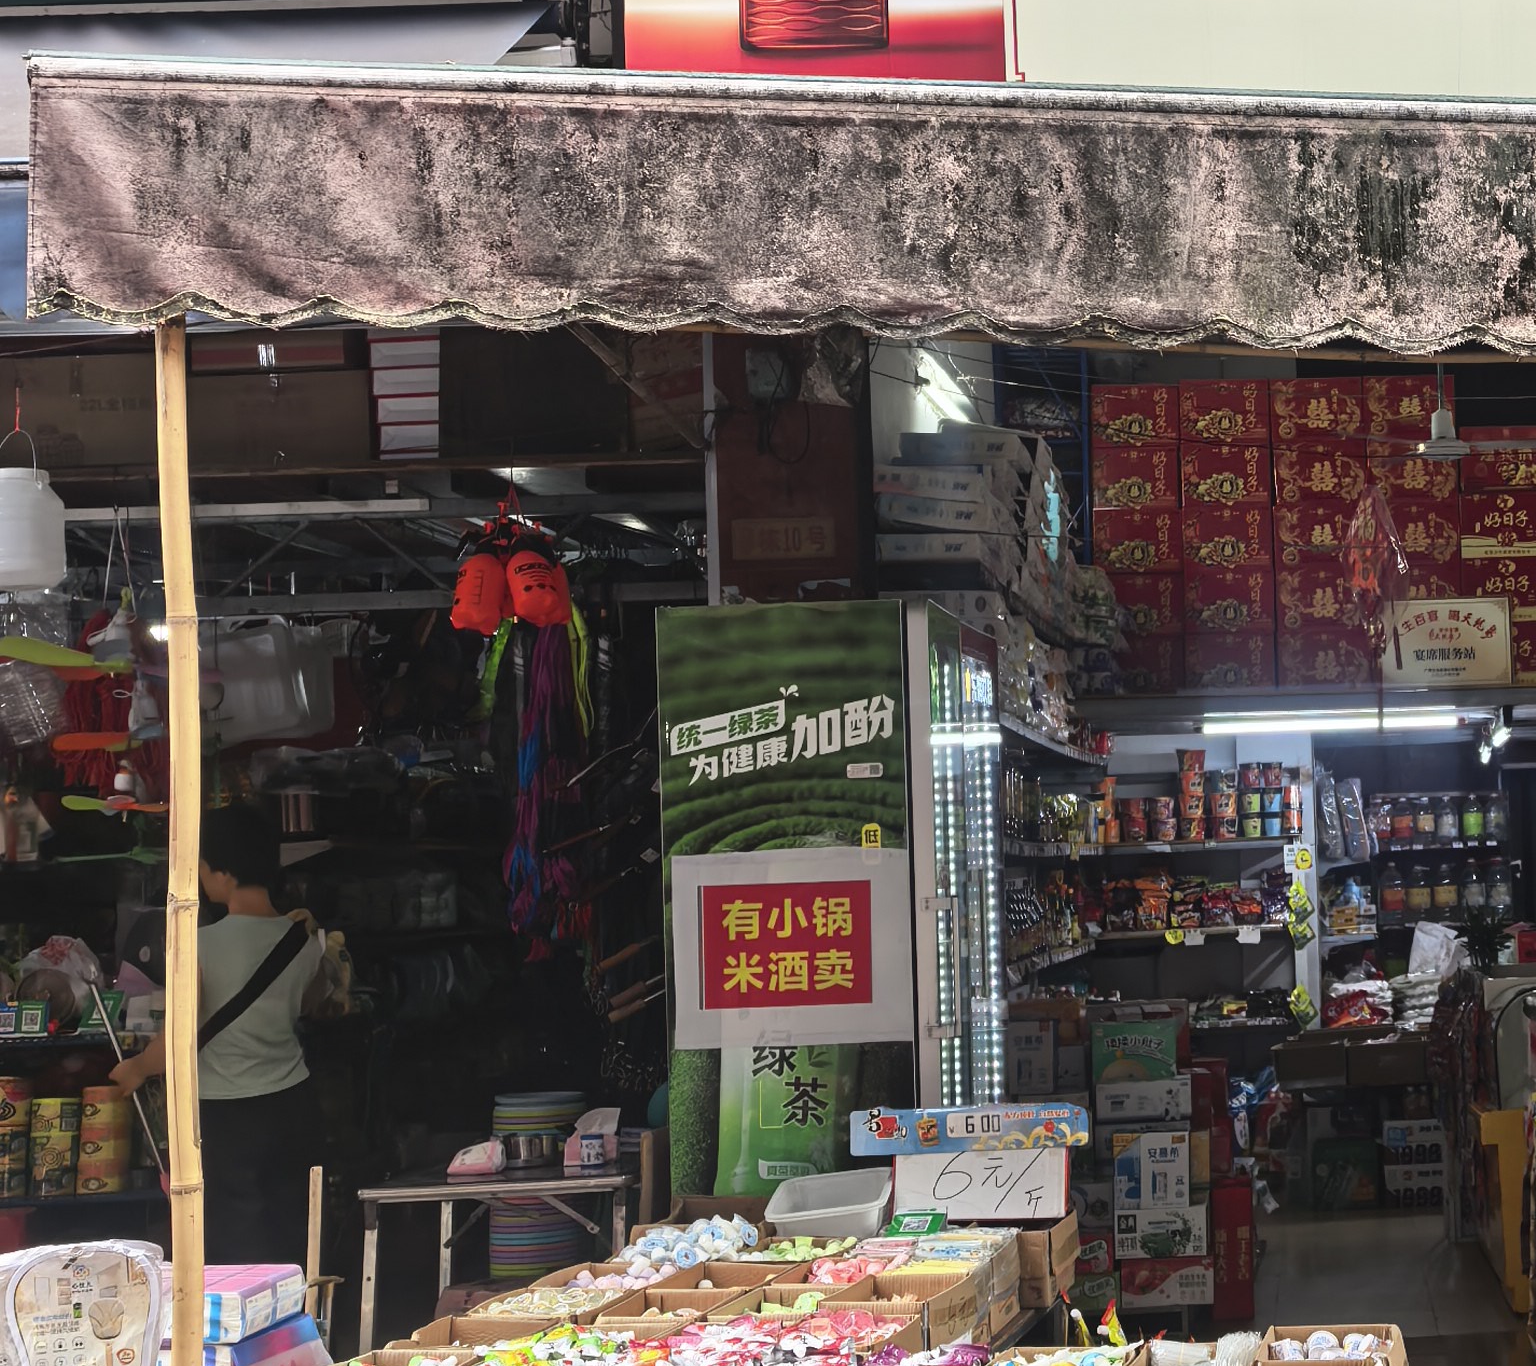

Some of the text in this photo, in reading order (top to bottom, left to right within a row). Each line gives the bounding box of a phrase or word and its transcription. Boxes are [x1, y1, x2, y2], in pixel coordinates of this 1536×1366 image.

[1484, 510, 1530, 527] 好日子
[1485, 575, 1531, 592] 好日子
[675, 704, 780, 751] 统一绿茶
[721, 897, 854, 942] 有小锅
[722, 948, 855, 994] 米酒卖
